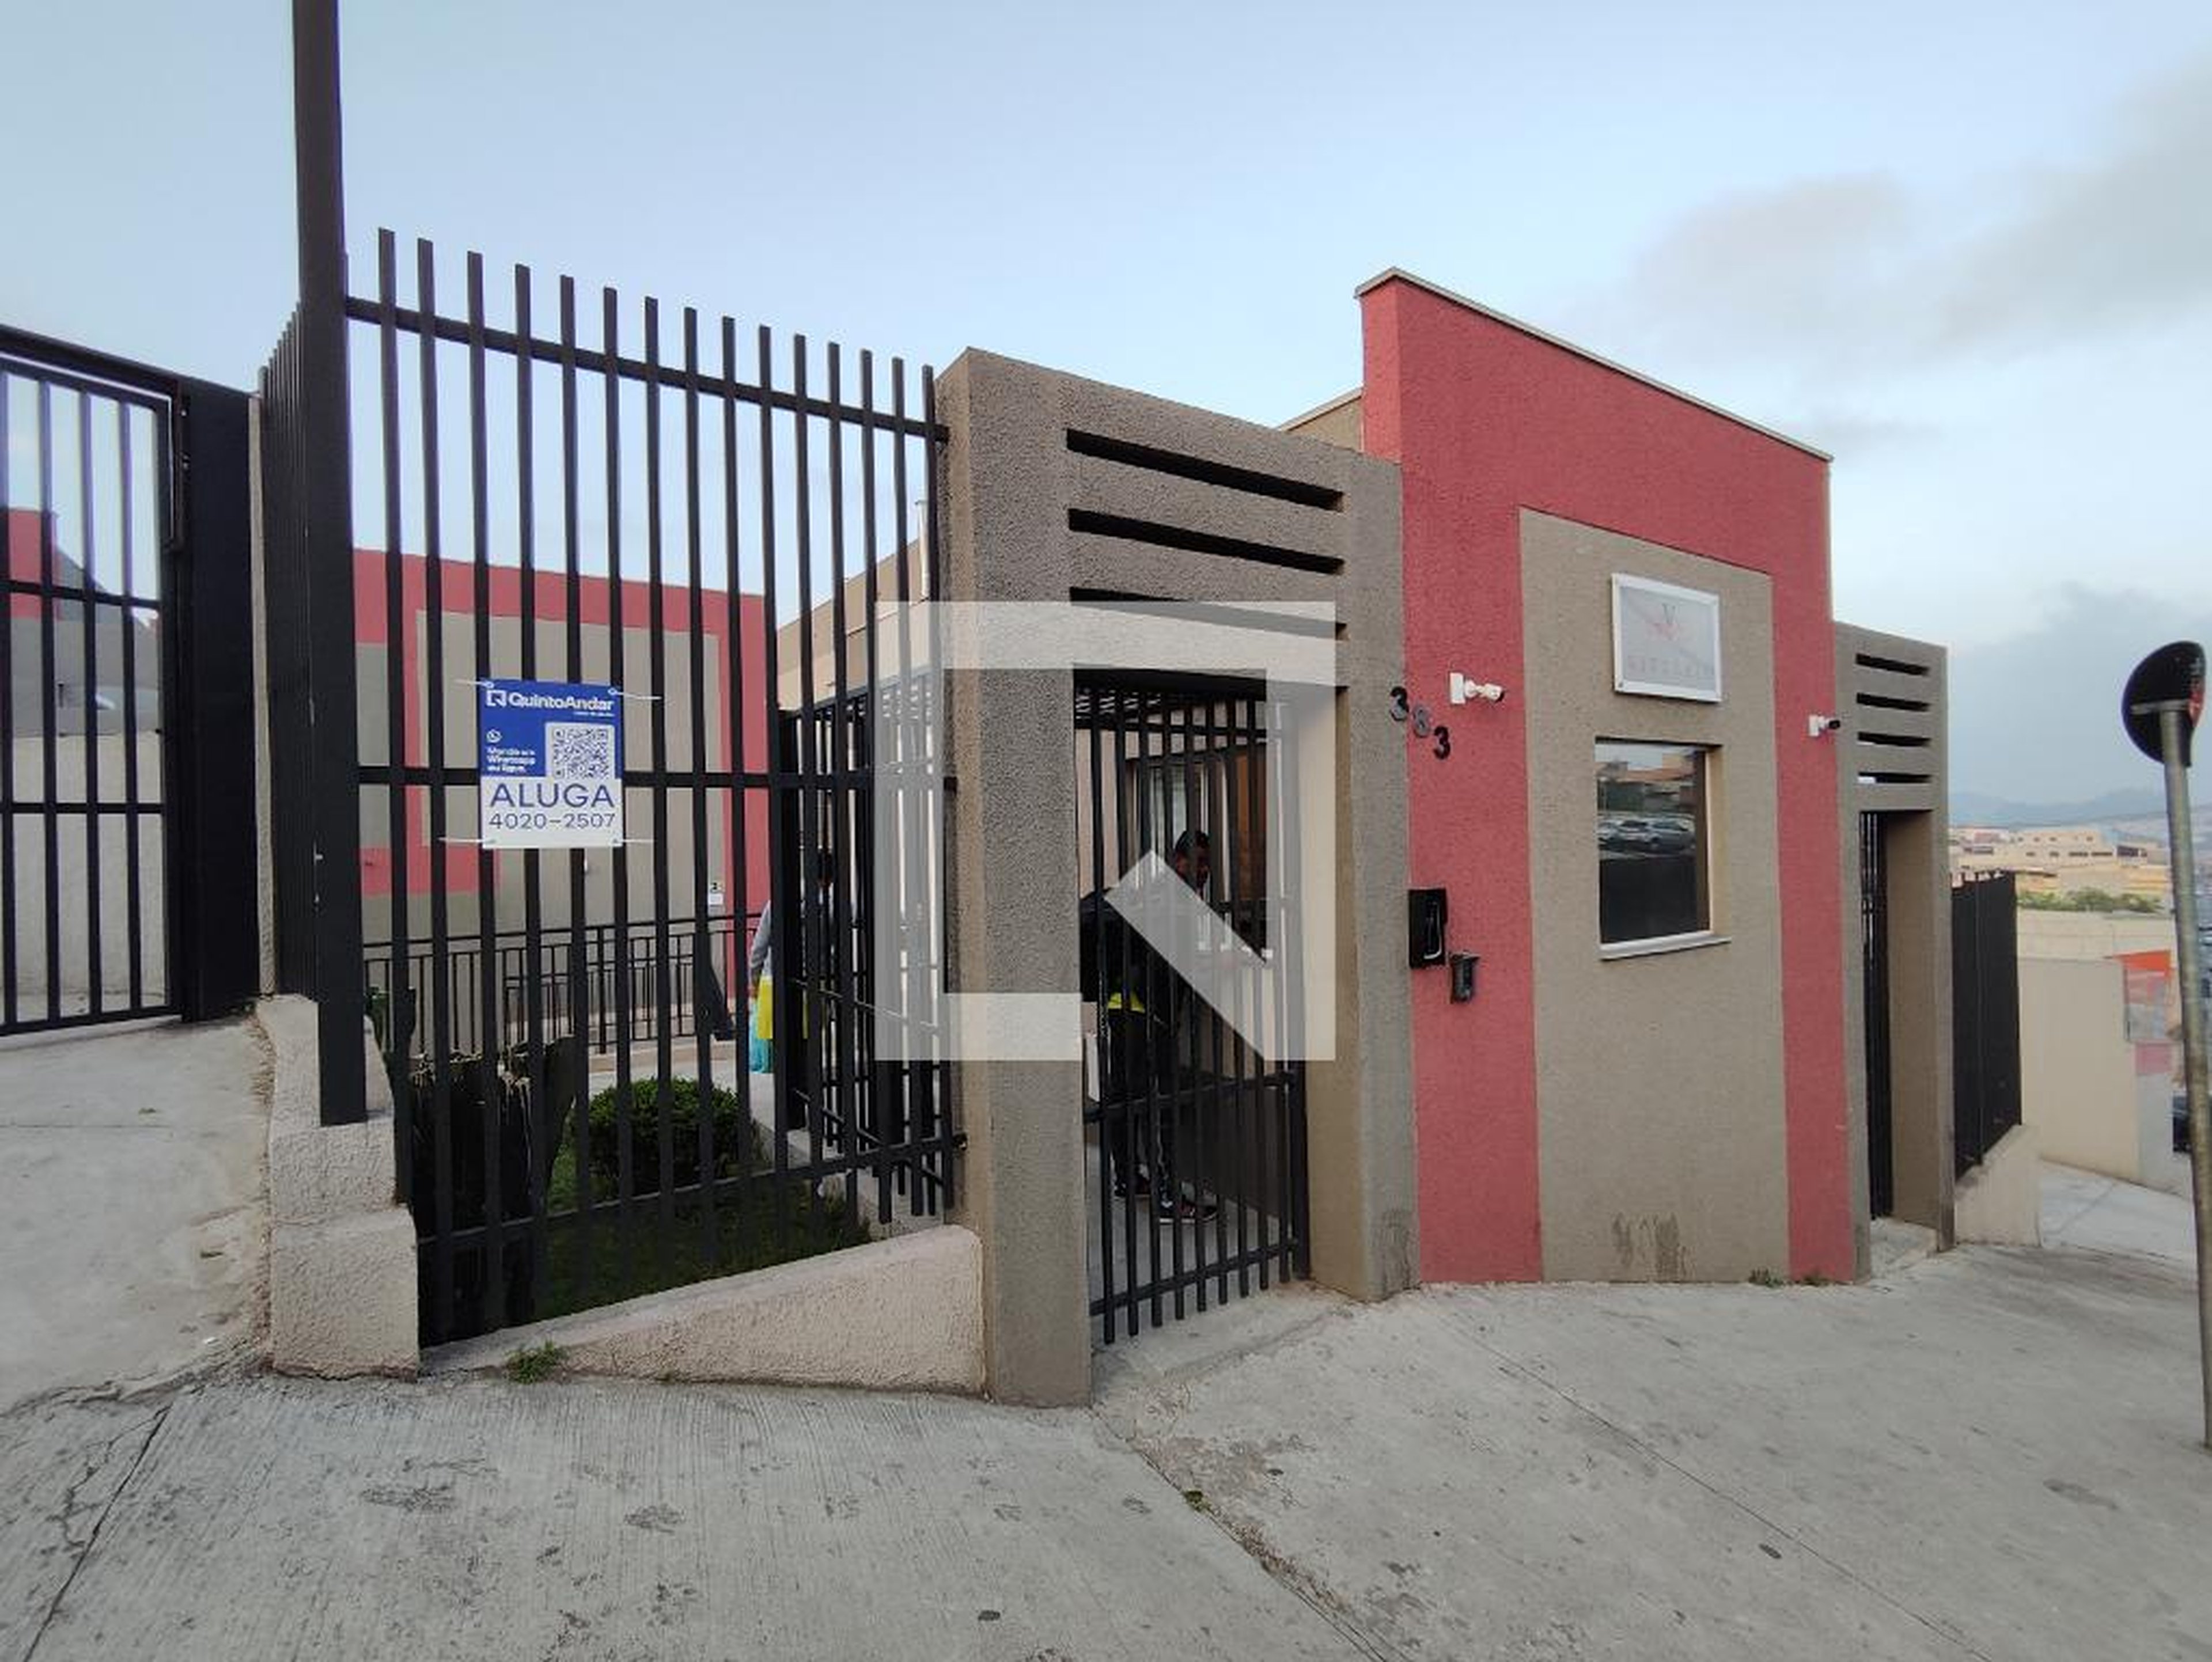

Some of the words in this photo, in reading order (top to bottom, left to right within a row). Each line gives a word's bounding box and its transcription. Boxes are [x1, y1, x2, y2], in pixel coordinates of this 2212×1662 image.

[508, 692, 614, 711] QuintoAndar
[490, 783, 615, 807] ALUGA
[489, 813, 616, 829] 4020-2507
